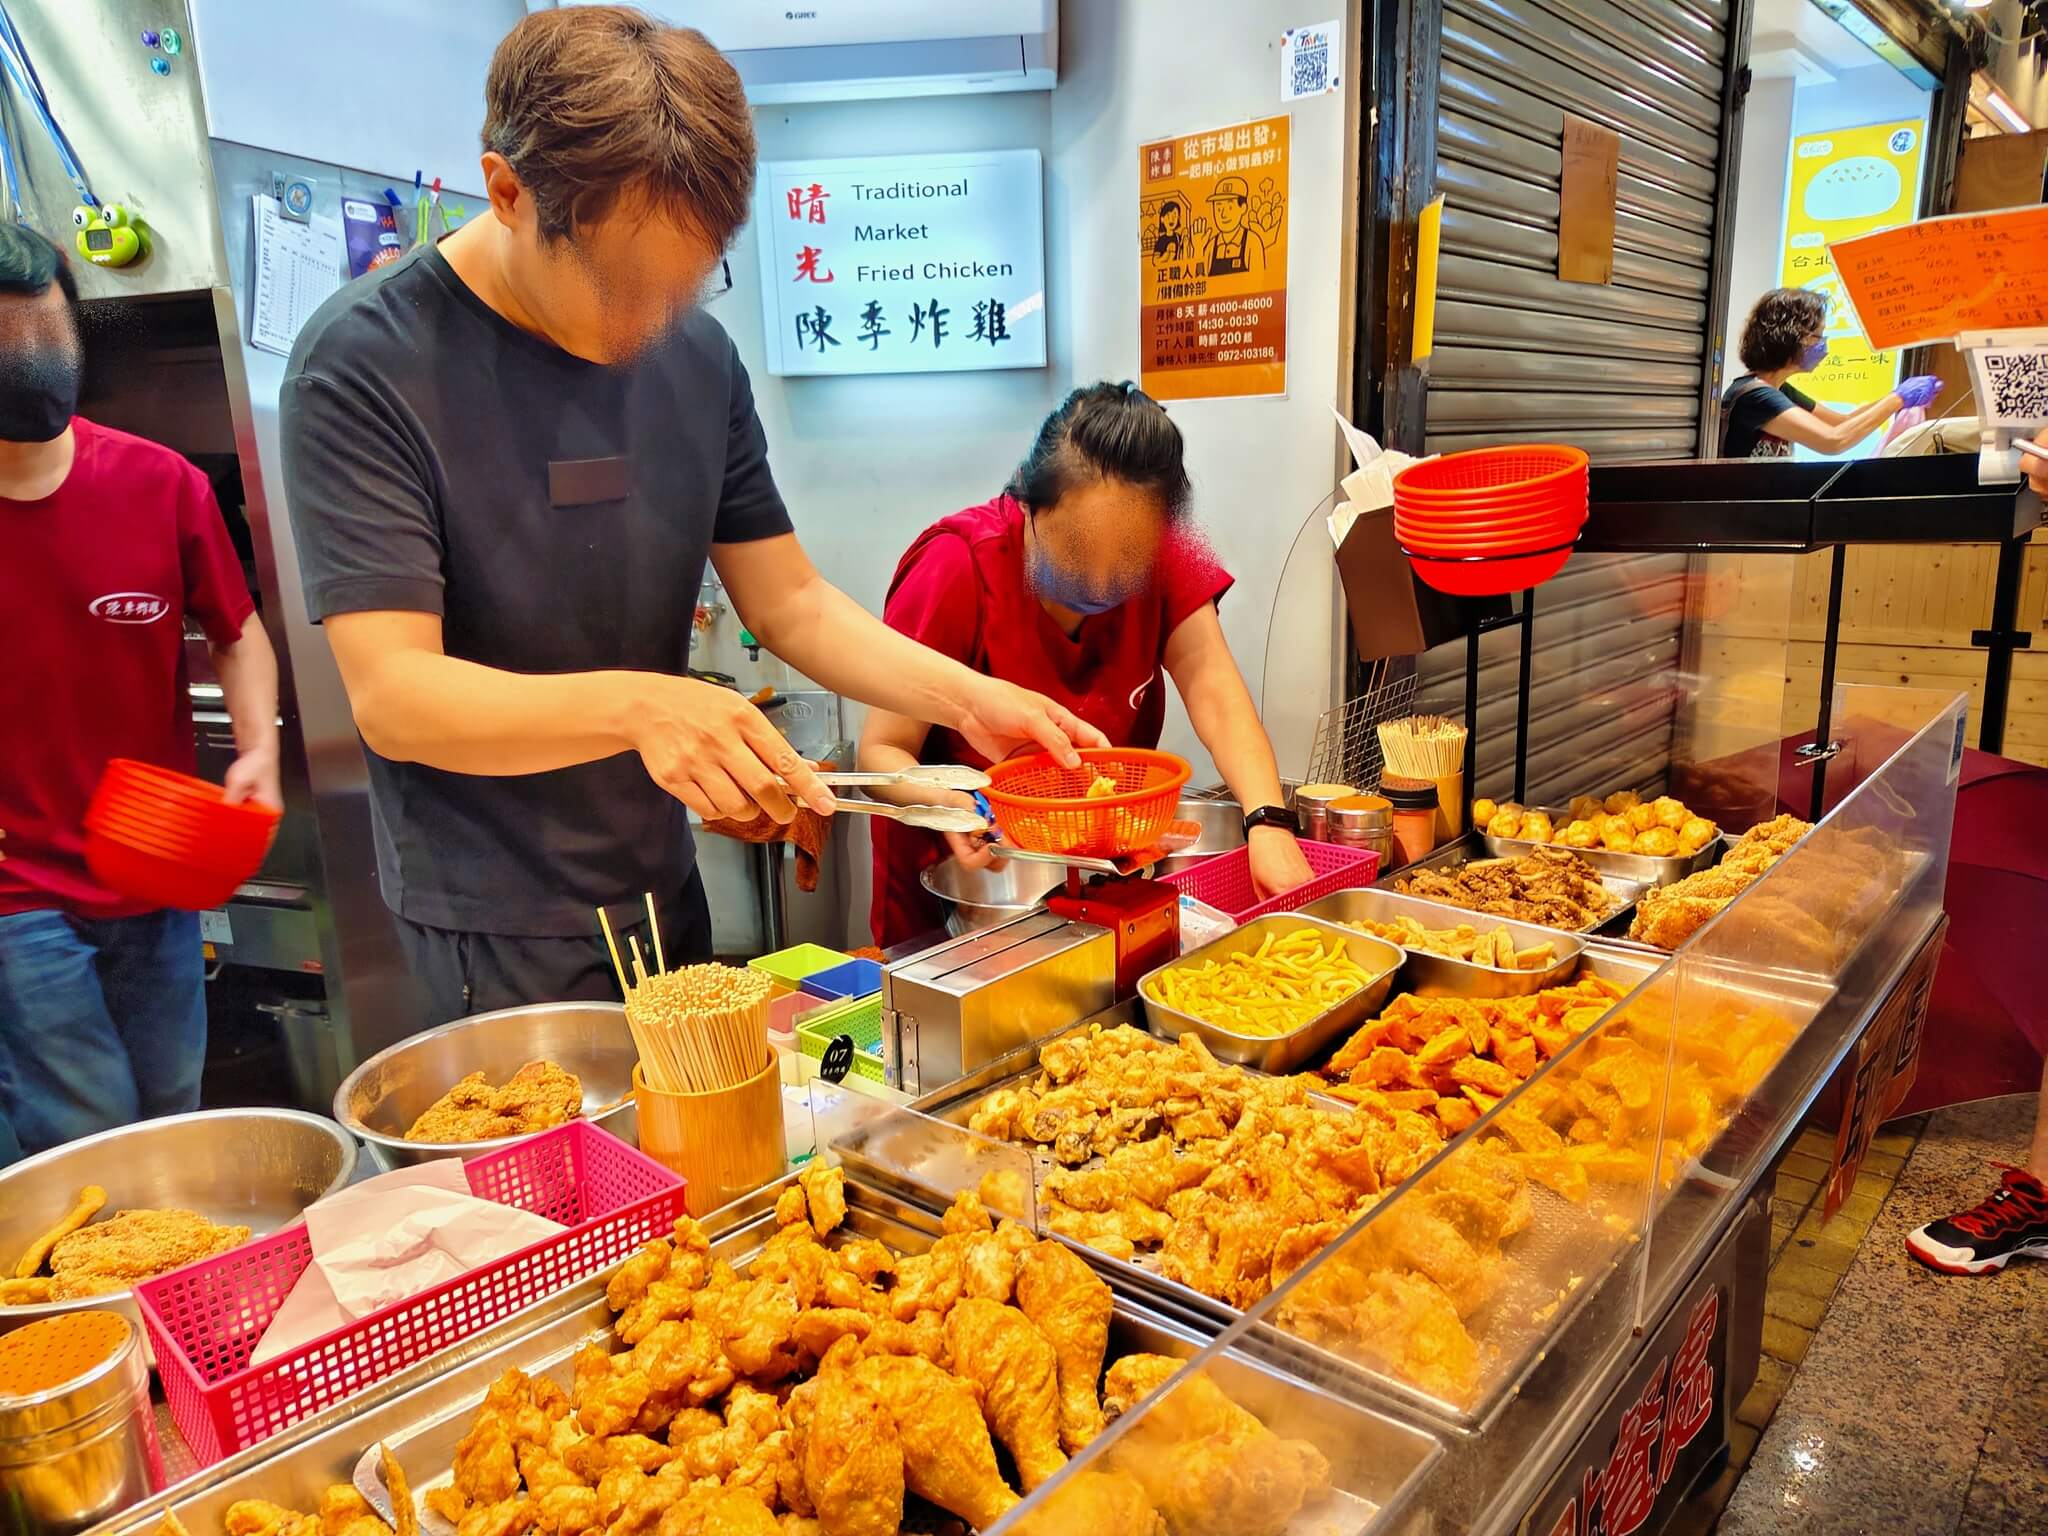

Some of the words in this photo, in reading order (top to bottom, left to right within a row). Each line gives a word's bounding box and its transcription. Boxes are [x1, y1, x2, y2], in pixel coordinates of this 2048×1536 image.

[1184, 124, 1276, 160] 從市場出發，
[851, 179, 968, 200] Traditional
[854, 223, 928, 241] Market
[858, 264, 914, 282] Fried
[923, 262, 1013, 279] Chicken
[1157, 262, 1206, 283] 正職人員
[1176, 307, 1183, 318] 8
[1209, 297, 1273, 315] 41000-46000
[796, 298, 1011, 353] 陳季炸雞
[1198, 314, 1259, 331] 14:30-00:30
[1156, 340, 1169, 350] PT
[1220, 333, 1241, 346] 200
[1218, 347, 1275, 362] 0972-103186
[830, 1048, 848, 1062] 07
